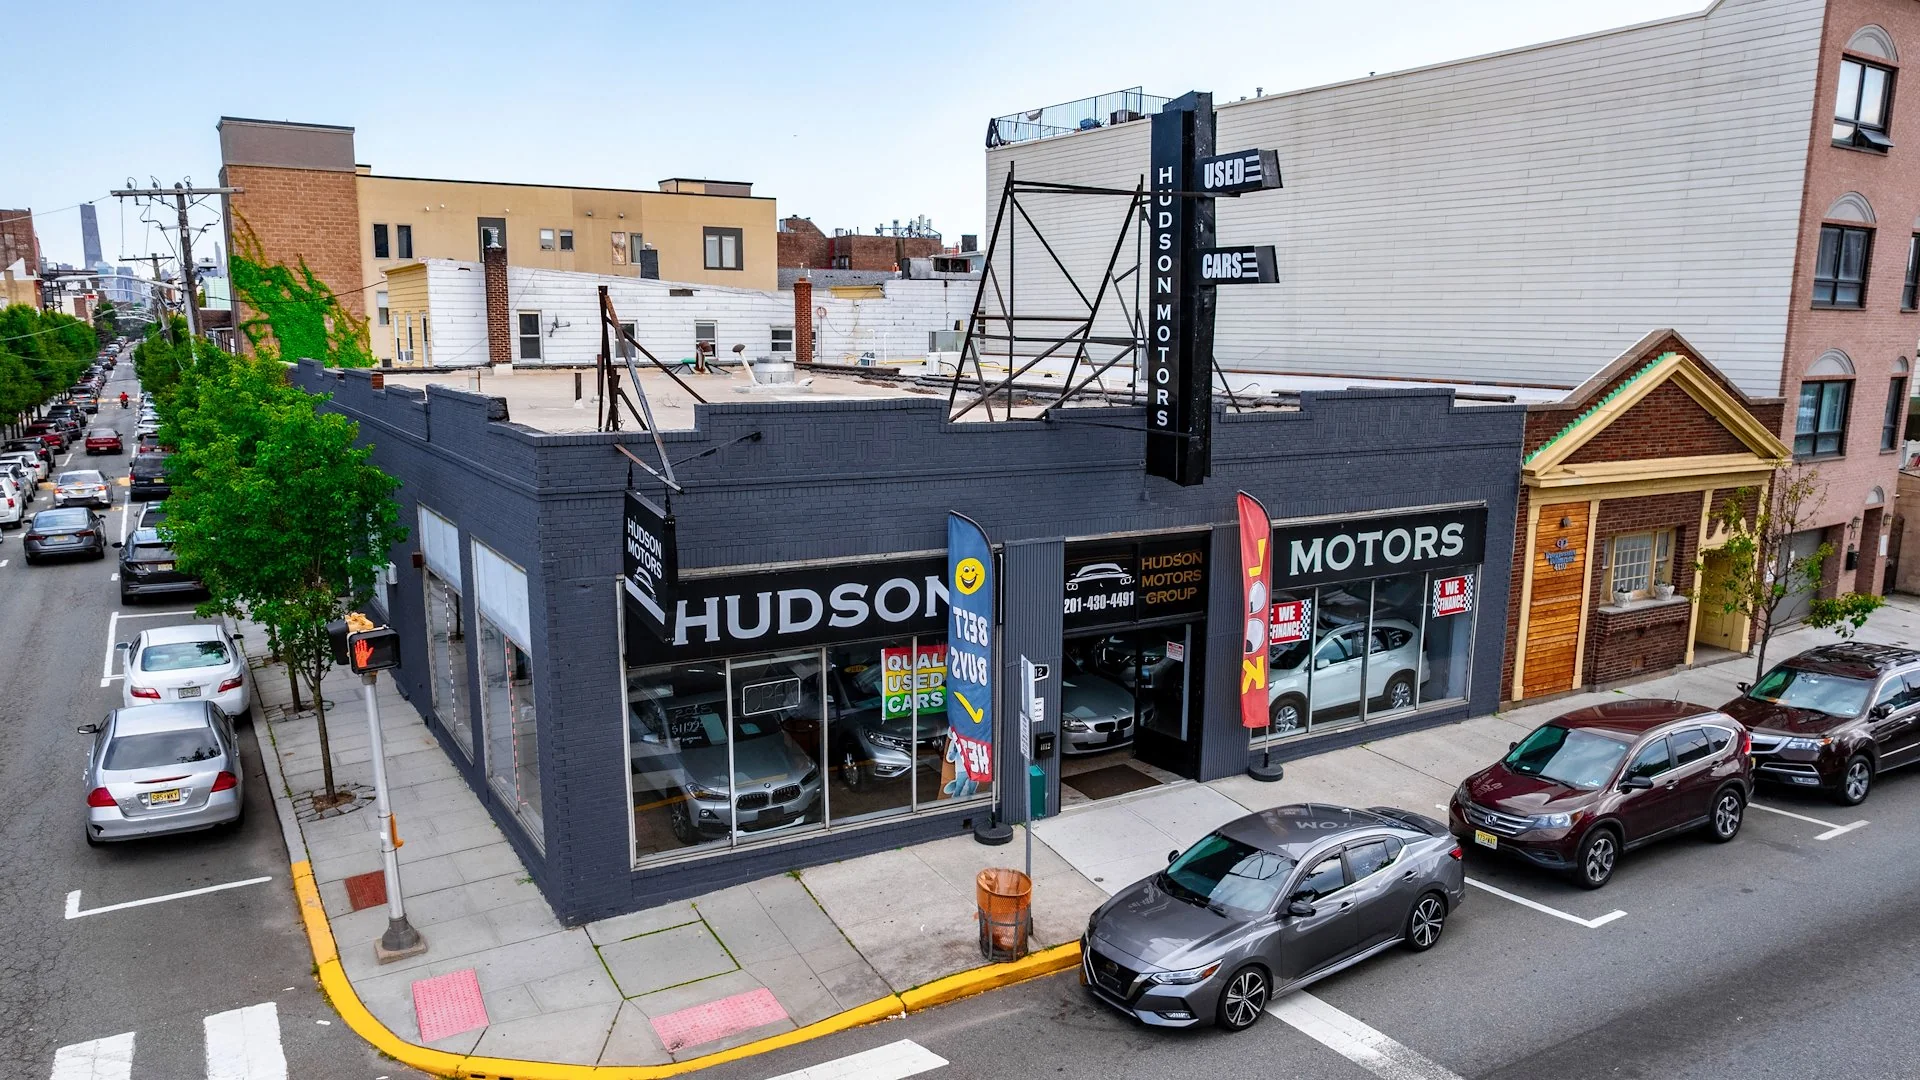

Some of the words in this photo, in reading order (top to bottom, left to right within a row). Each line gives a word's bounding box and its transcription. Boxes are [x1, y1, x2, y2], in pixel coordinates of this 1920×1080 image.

[1204, 158, 1244, 189] USED
[1157, 166, 1173, 295] HUDSON
[1202, 252, 1242, 279] CARS
[1156, 304, 1171, 427] MOTORS
[627, 517, 662, 560] HUDSON
[1289, 522, 1465, 577] MOTORS
[627, 536, 663, 580] MOTORS
[1141, 551, 1203, 571] HUDSON
[1142, 569, 1202, 588] MOTORS
[1444, 579, 1460, 595] WE
[1063, 590, 1135, 614] 201-430-4491
[1146, 587, 1198, 605] GROUP
[1438, 593, 1465, 612] FINANCE
[1278, 605, 1296, 622] WE
[1271, 621, 1301, 639] FINANCE
[887, 652, 948, 672] QUAL
[887, 671, 944, 693] USED
[887, 690, 944, 715] CARS
